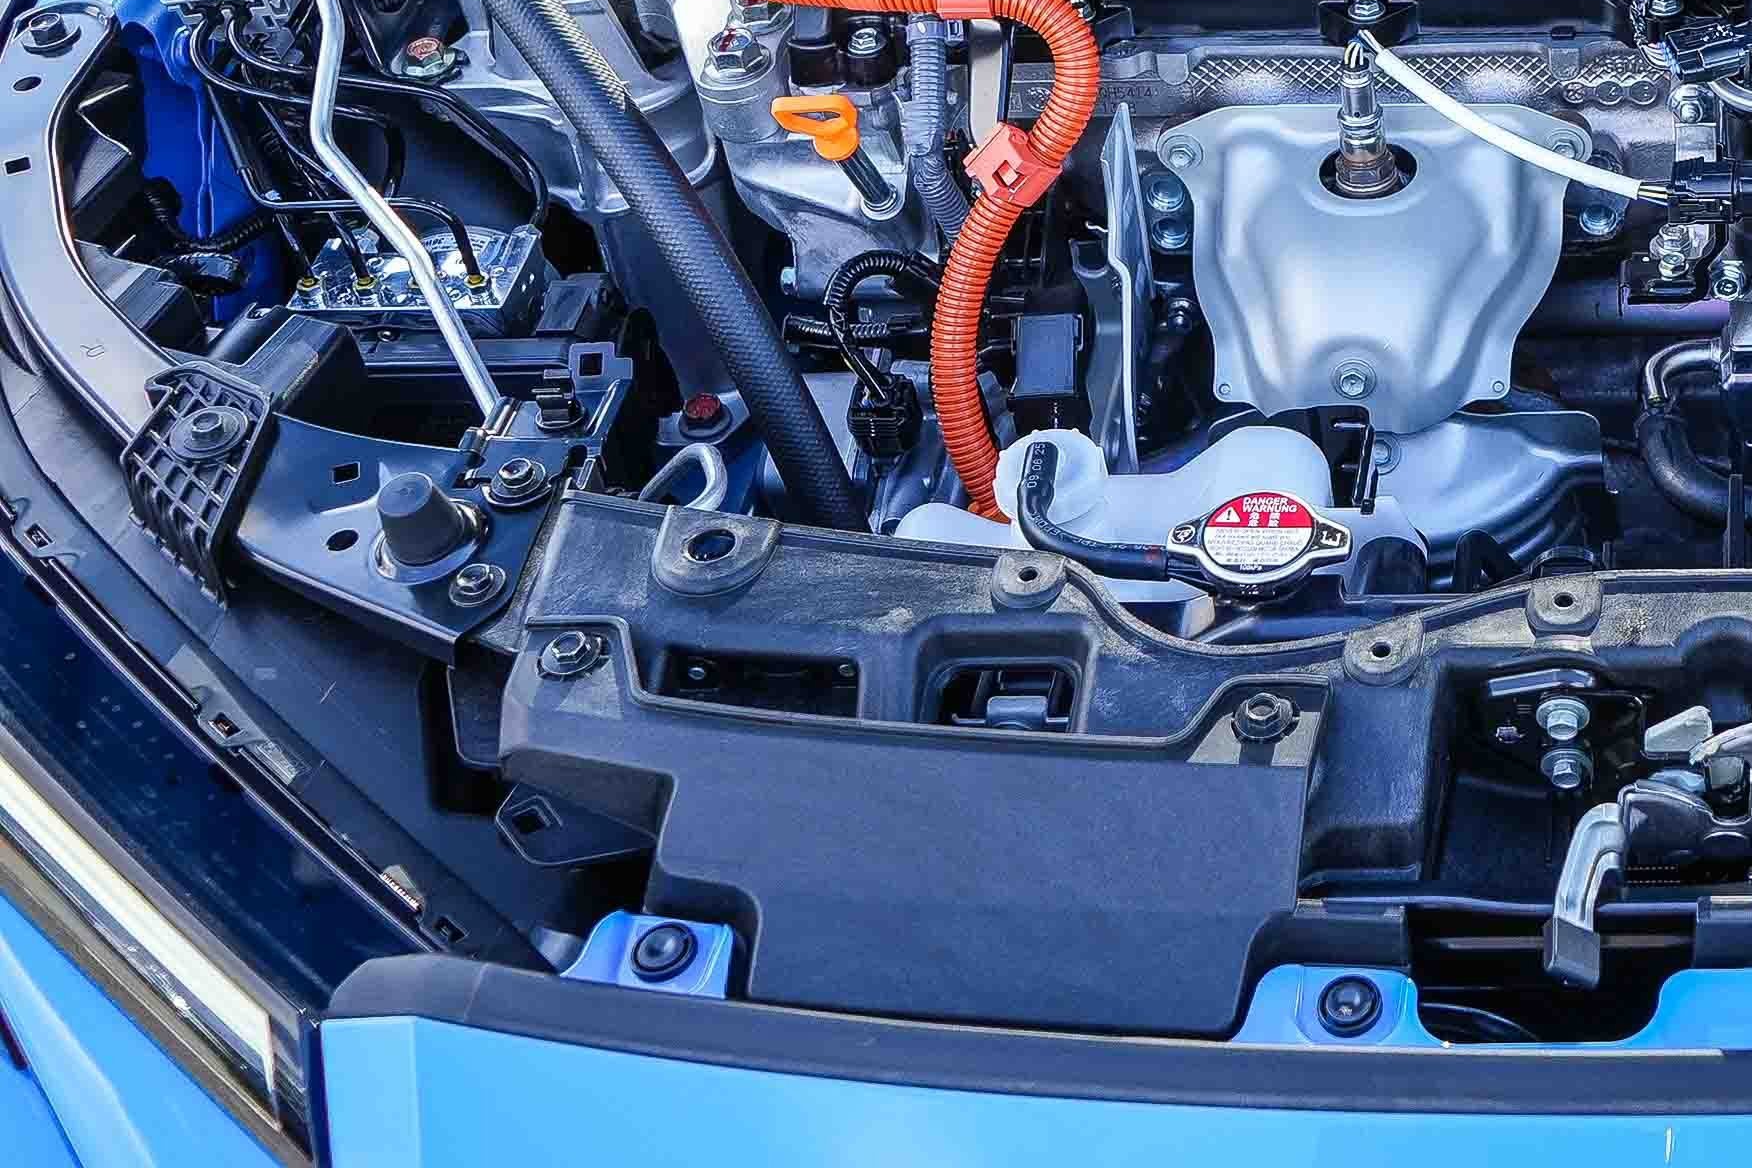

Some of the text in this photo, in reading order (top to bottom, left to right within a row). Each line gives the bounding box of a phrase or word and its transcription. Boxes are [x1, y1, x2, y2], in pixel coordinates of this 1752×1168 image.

[1027, 475, 1040, 488] 09
[1035, 443, 1045, 455] 25
[1242, 496, 1289, 505] DANGER
[1242, 504, 1298, 513] WARNUNG
